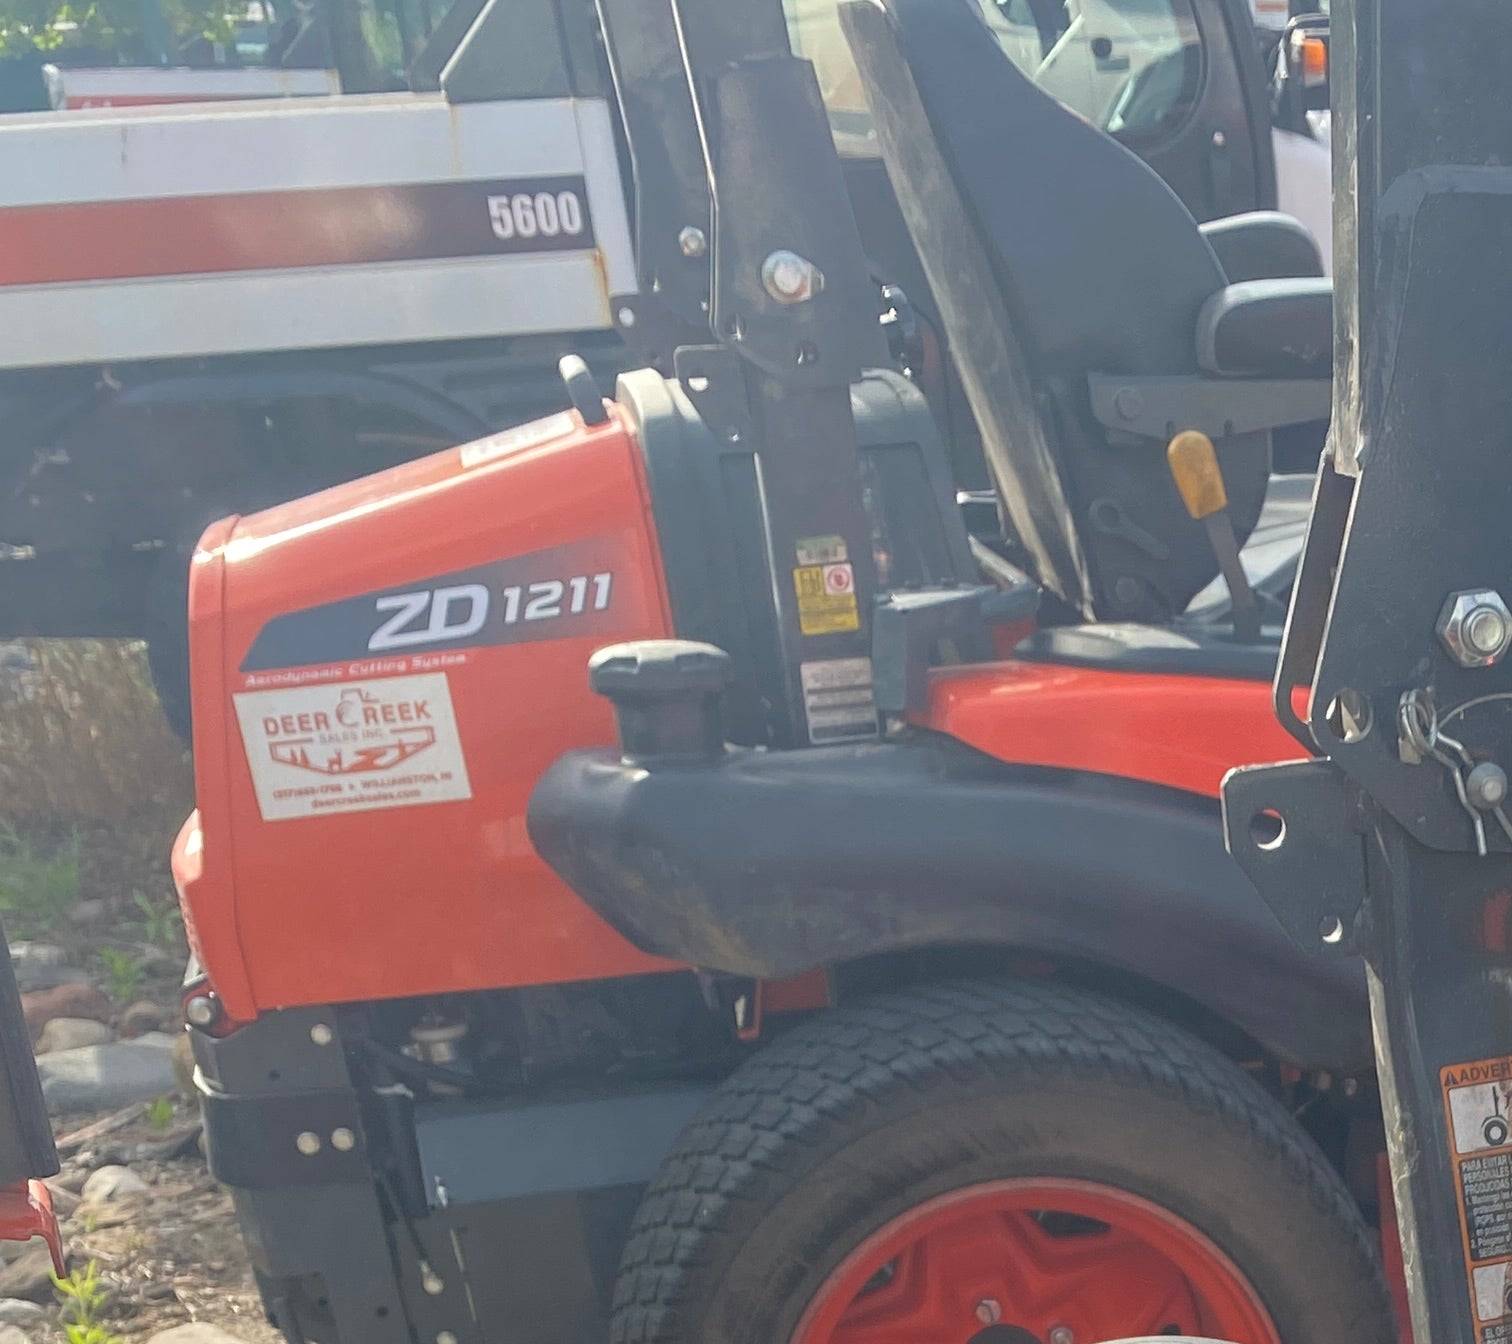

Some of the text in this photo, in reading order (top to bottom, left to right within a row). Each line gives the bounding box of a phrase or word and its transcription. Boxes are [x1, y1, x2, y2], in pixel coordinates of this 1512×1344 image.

[487, 190, 583, 239] 5600
[367, 571, 611, 651] ZD 1211
[245, 652, 467, 688] Aerodynamic Cutting System
[262, 699, 432, 737] DEER CREEK
[319, 730, 358, 746] SALES
